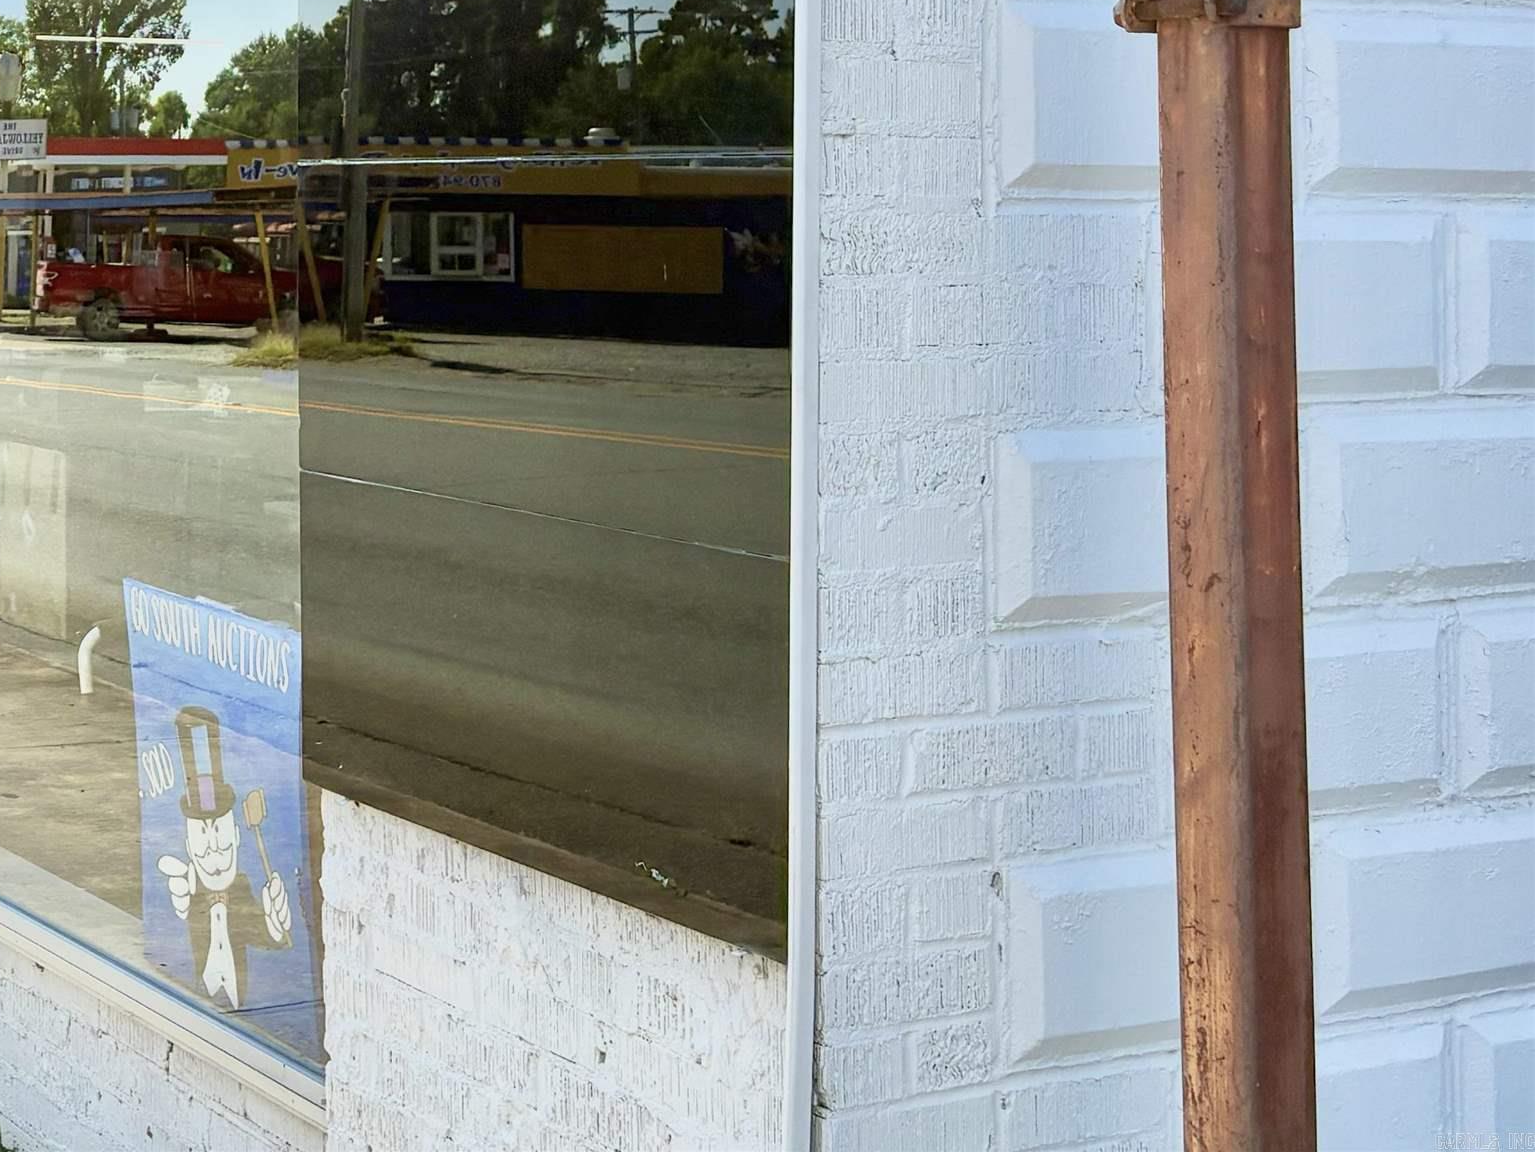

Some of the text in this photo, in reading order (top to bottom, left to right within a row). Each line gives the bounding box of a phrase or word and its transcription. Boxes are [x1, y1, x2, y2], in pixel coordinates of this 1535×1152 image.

[130, 586, 291, 695] GO SOUTH AUCTIONS
[142, 742, 175, 798] SOLD
